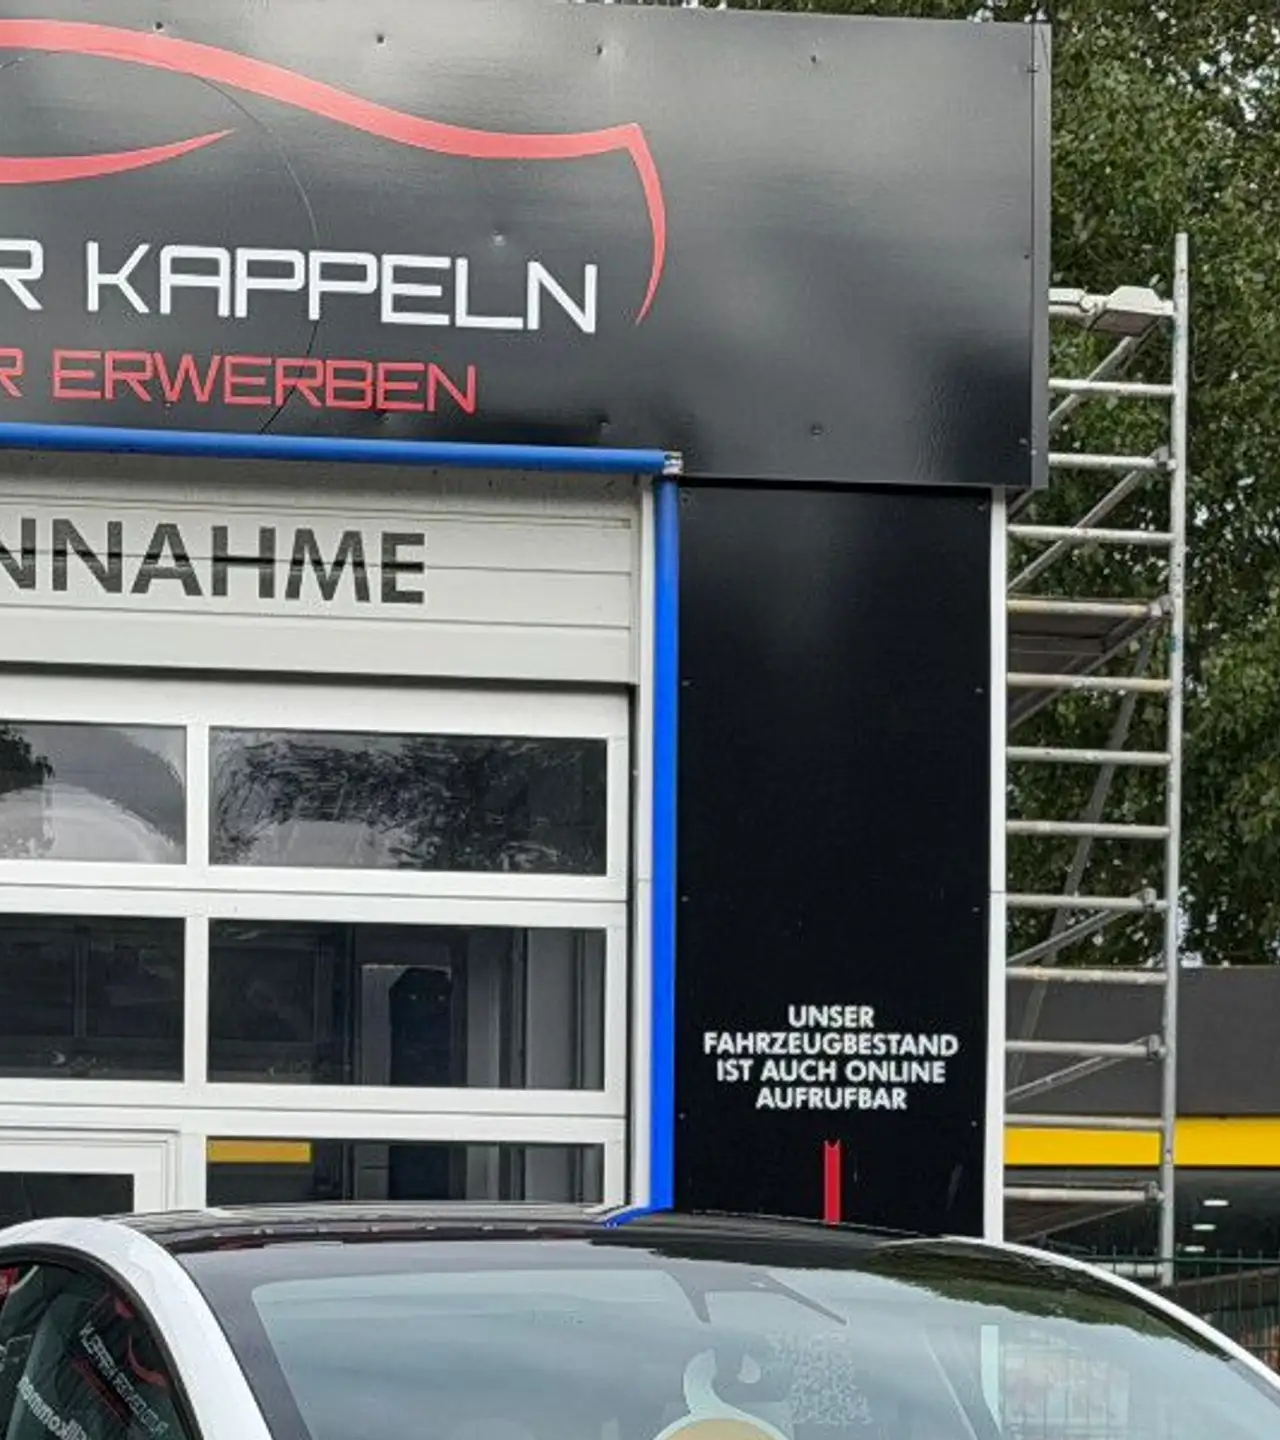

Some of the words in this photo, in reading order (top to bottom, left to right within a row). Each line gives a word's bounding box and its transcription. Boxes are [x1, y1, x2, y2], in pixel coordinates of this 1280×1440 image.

[86, 240, 598, 334] KAPPELN
[52, 350, 477, 414] ERWERBEN
[788, 1005, 875, 1029] UNSER
[704, 1031, 959, 1057] FAHRZEUGBESTAND
[716, 1058, 754, 1082] IST
[760, 1059, 837, 1082] AUCH
[844, 1059, 946, 1083] ONLINE
[755, 1086, 907, 1110] AUFRUFBAR
